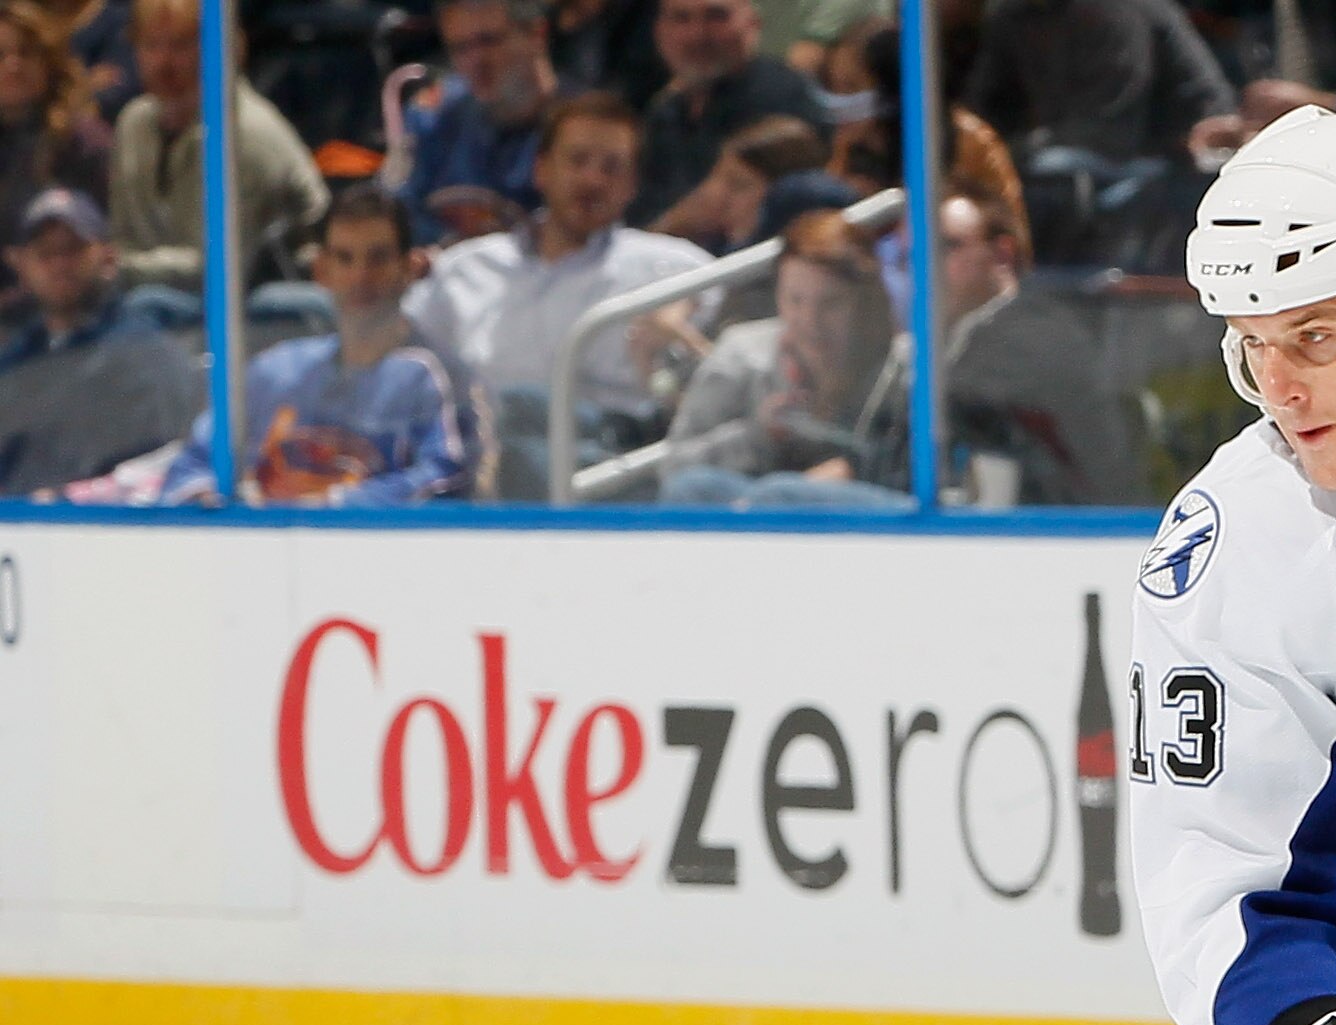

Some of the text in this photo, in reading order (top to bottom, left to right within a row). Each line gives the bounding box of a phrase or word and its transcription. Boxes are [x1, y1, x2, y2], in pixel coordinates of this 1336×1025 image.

[1200, 262, 1254, 276] CCM
[275, 616, 1058, 898] Coke zero
[1129, 662, 1226, 788] 13
